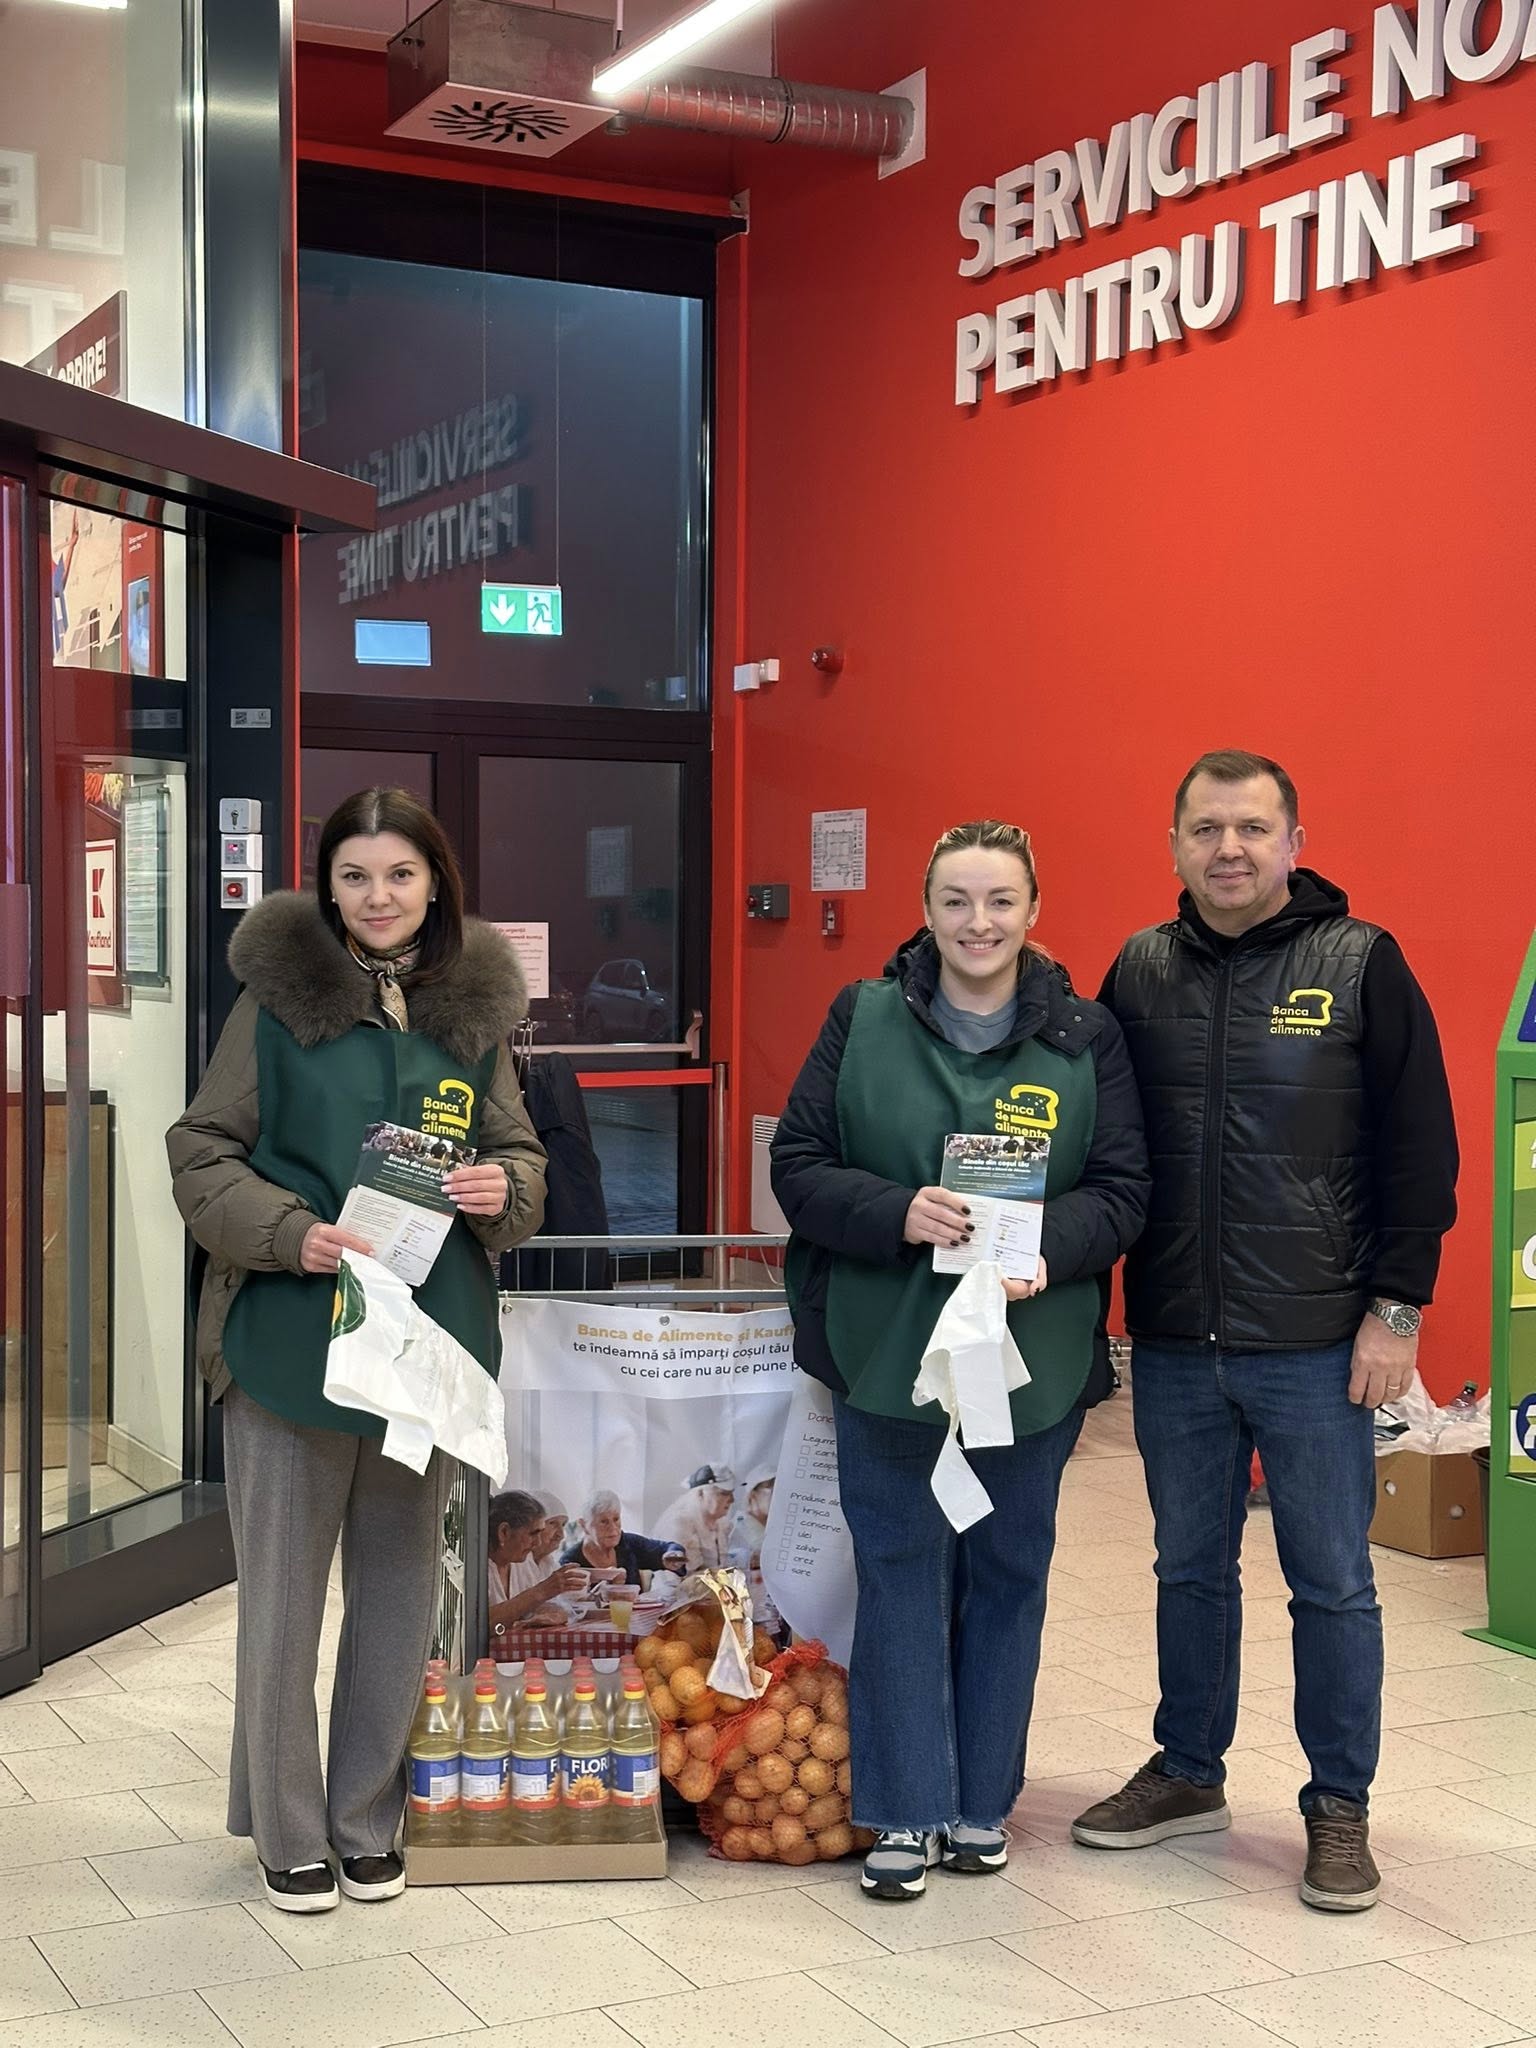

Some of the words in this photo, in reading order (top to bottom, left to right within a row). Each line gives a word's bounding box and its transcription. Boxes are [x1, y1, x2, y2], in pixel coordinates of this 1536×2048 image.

[958, 27, 1347, 280] SERVICIILE
[1371, 0, 1536, 119] NO
[955, 220, 1241, 407] PENTRU
[1259, 133, 1478, 306] TINE
[1272, 1005, 1309, 1016] Banca
[1271, 1016, 1284, 1025] de
[1270, 1025, 1322, 1036] alimente
[423, 1096, 459, 1114] Banca
[995, 1098, 1035, 1116] Banca
[422, 1110, 438, 1121] de
[995, 1110, 1009, 1122] de
[995, 1121, 1050, 1140] alimente
[577, 1323, 628, 1340] Banca
[632, 1329, 654, 1342] de
[658, 1328, 734, 1343] Alimente
[738, 1327, 751, 1344] și
[573, 1341, 587, 1352] te
[589, 1342, 659, 1361] îndeamnă
[662, 1348, 677, 1360] să
[679, 1347, 729, 1361] împarți
[732, 1344, 766, 1358] coșul
[769, 1342, 790, 1354] tău
[620, 1365, 637, 1376] cu
[640, 1367, 660, 1378] cei
[663, 1368, 692, 1379] care
[695, 1366, 712, 1376] nu
[715, 1365, 731, 1375] au
[734, 1364, 750, 1374] ce
[753, 1360, 787, 1375] pune
[802, 1433, 835, 1447] Legume
[799, 1520, 841, 1533] conserve
